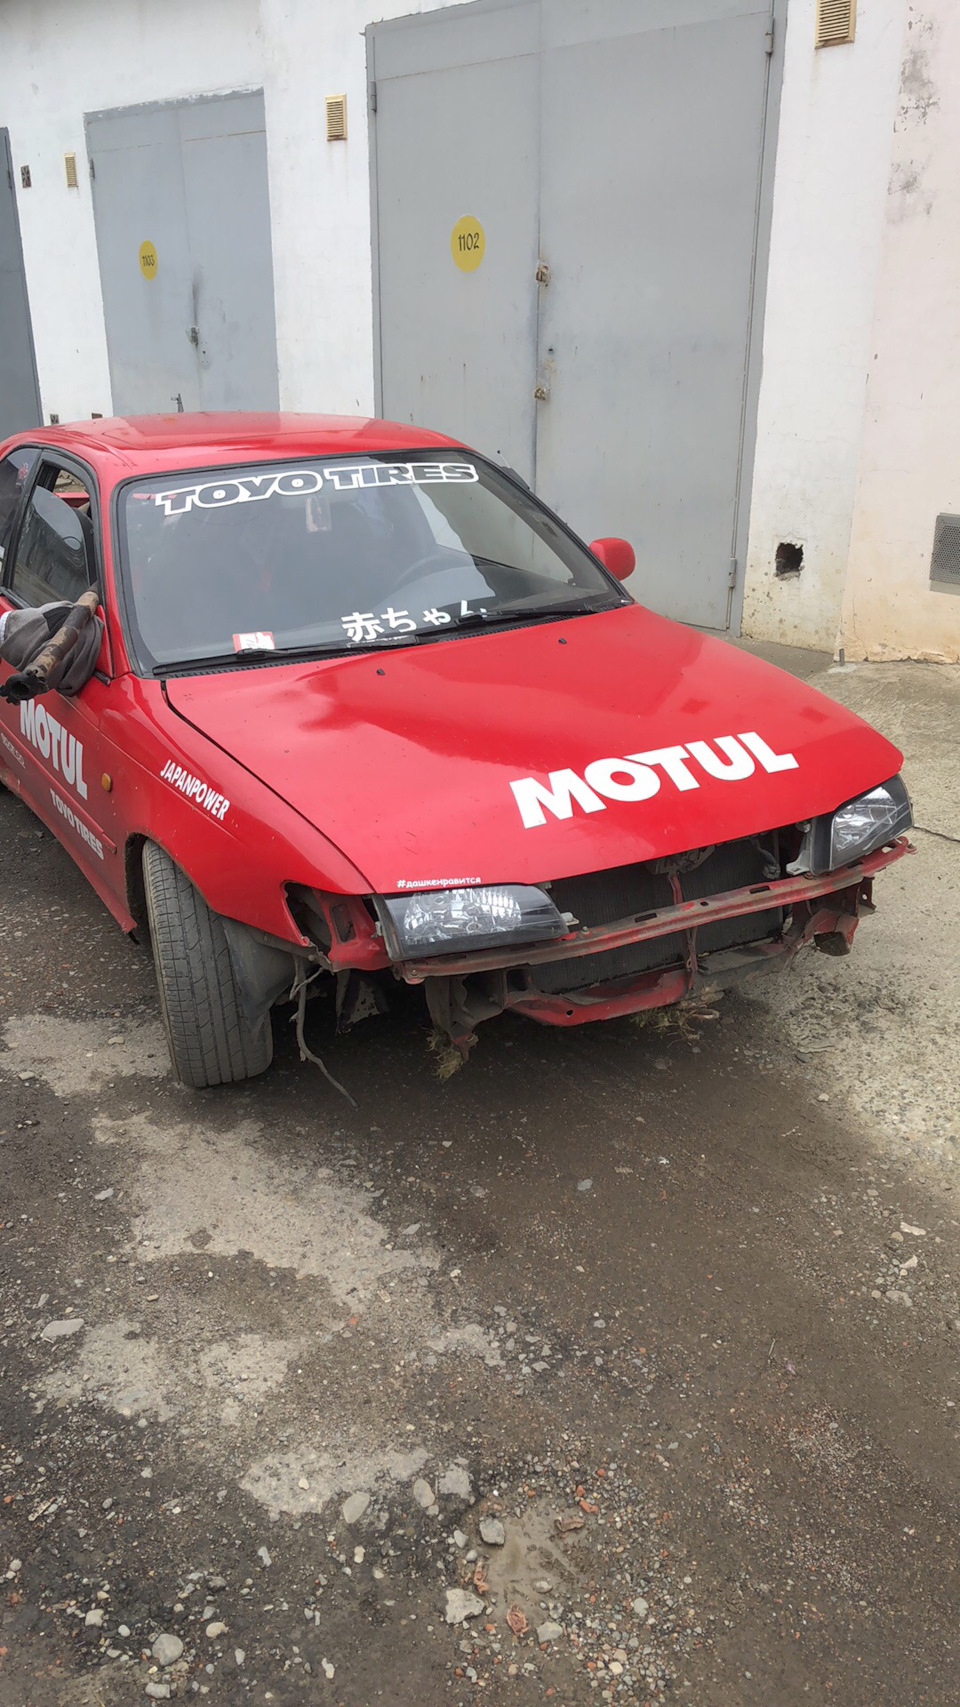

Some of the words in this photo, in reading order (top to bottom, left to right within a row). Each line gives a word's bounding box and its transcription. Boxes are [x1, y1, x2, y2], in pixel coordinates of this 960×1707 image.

[142, 254, 155, 267] 1103
[458, 232, 480, 252] 1102
[155, 470, 323, 515] TOYO
[323, 463, 479, 490] TIRES
[20, 699, 88, 801] MOTUL
[160, 759, 231, 821] JAPANPOWER
[509, 731, 799, 829] MOTUL
[50, 788, 75, 827] TOYO
[74, 814, 104, 860] TIRES
[396, 877, 482, 889] #дашкенравится
